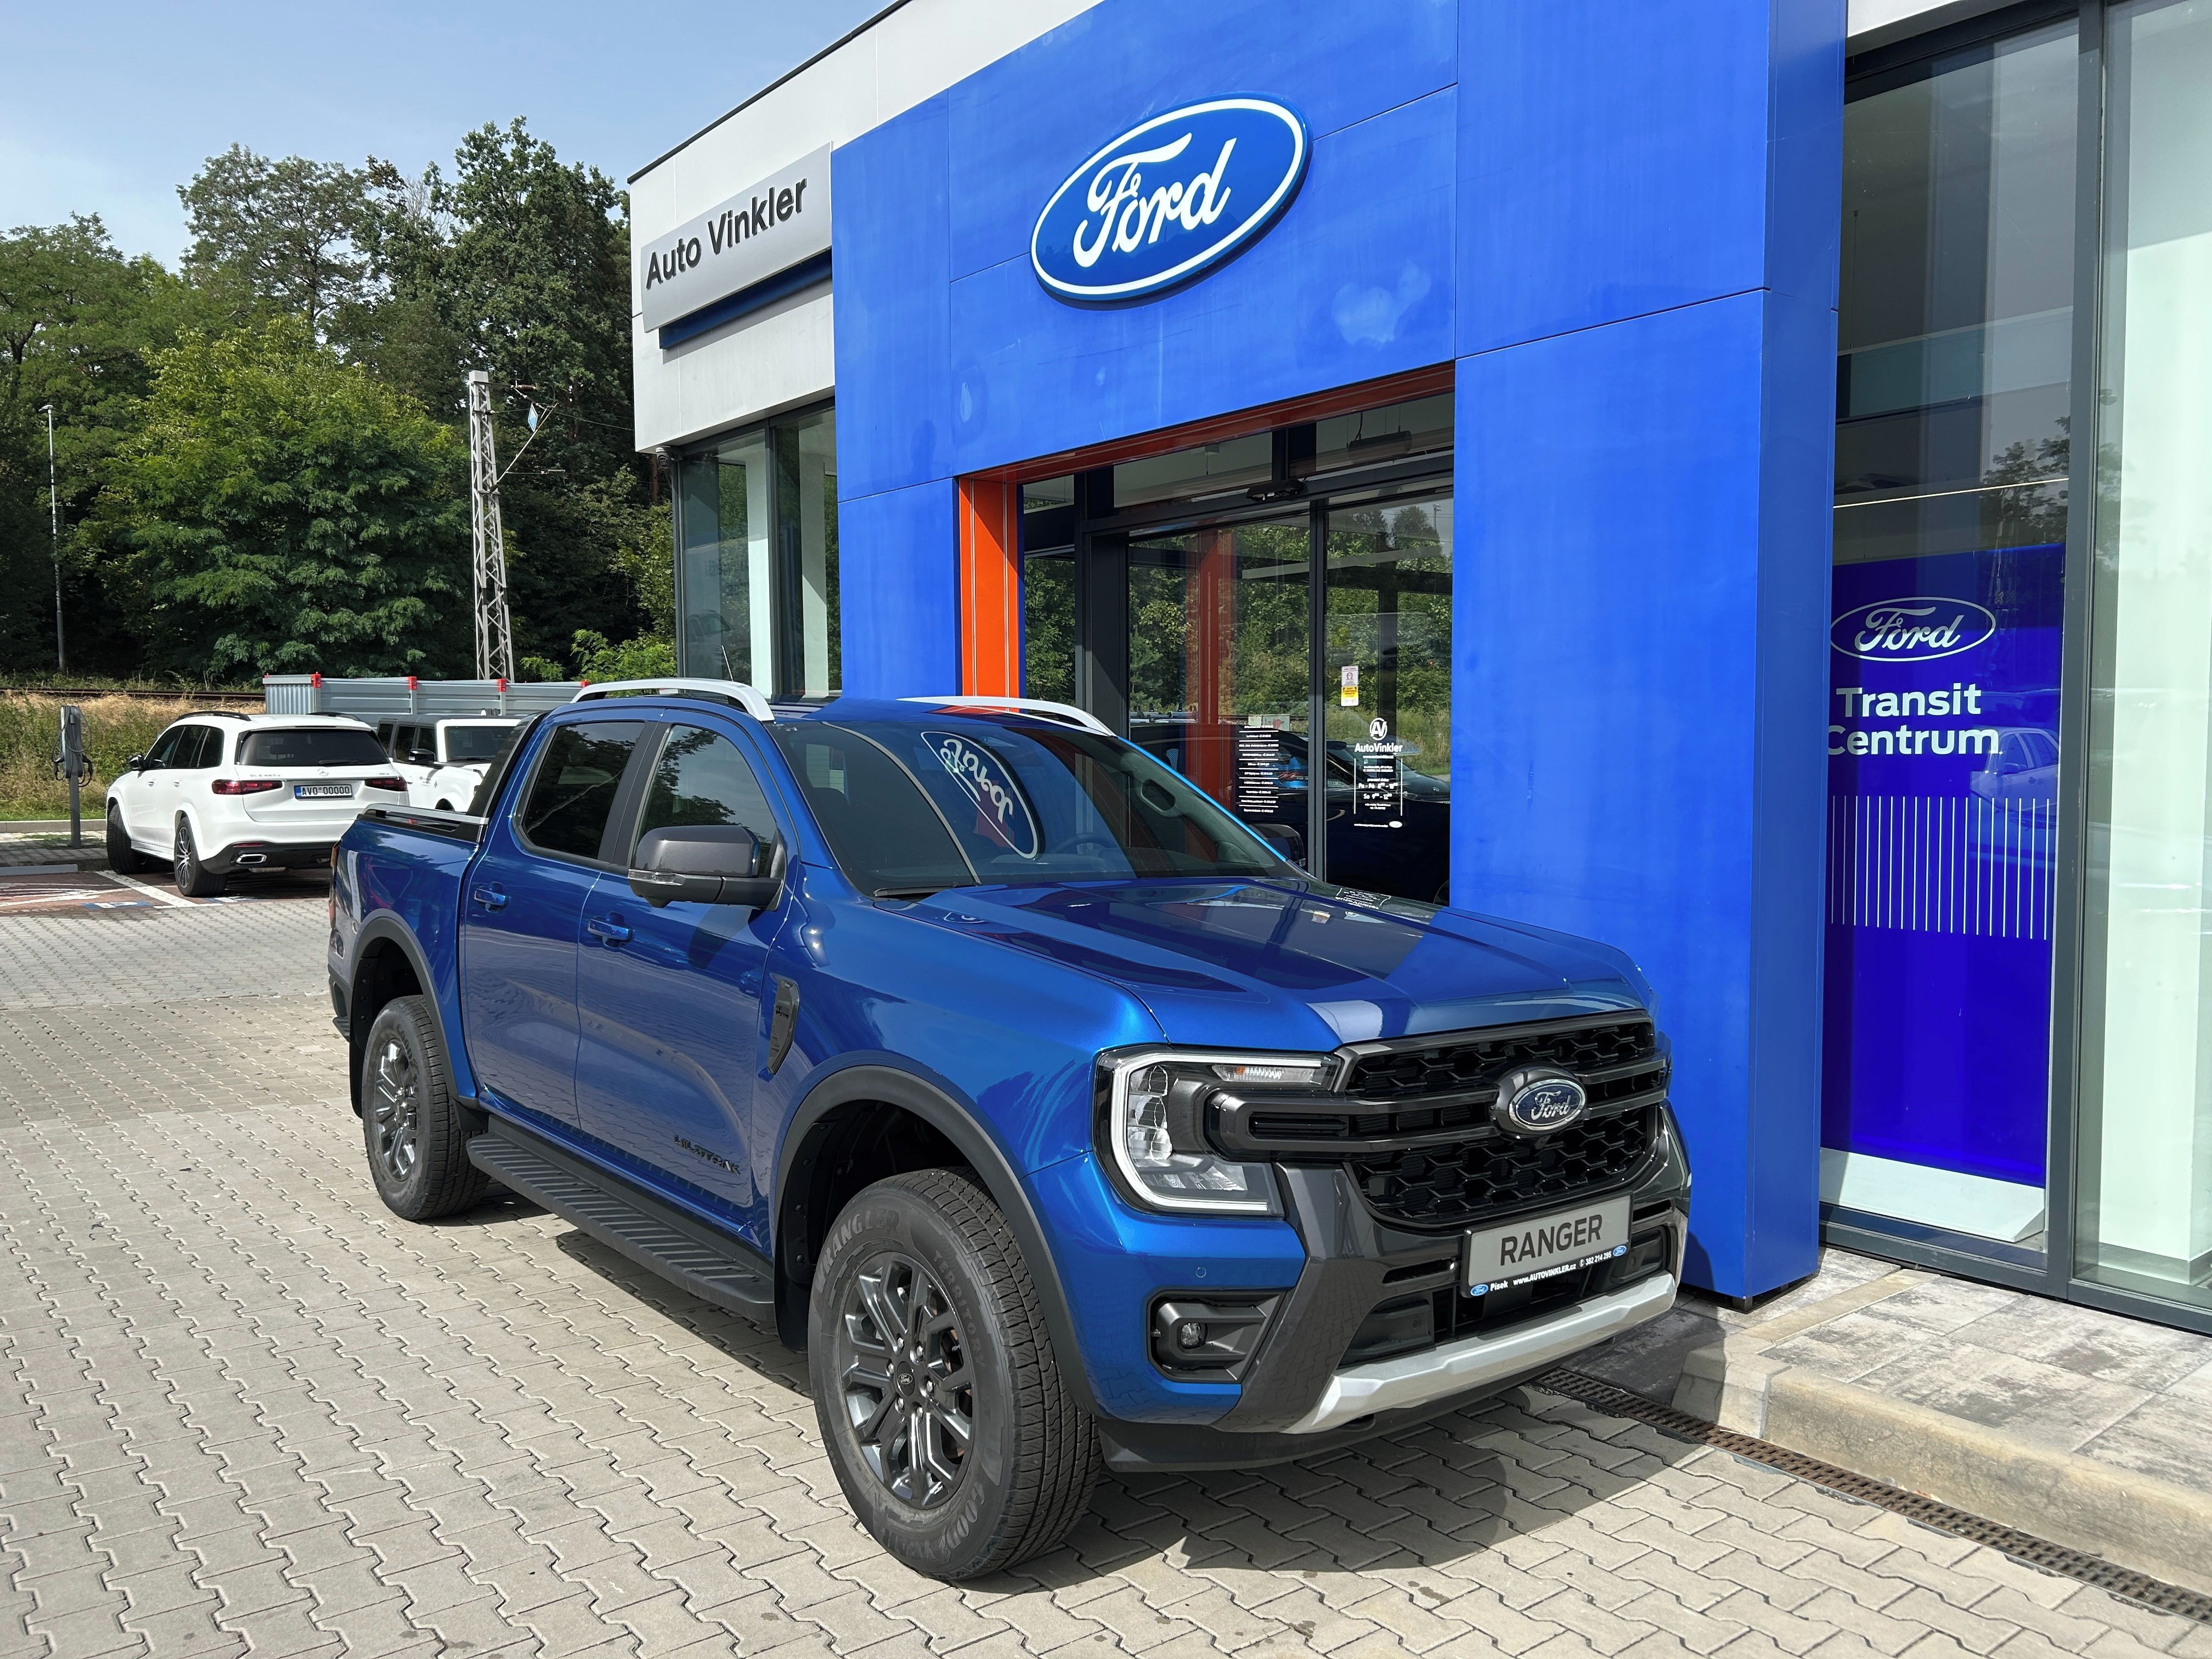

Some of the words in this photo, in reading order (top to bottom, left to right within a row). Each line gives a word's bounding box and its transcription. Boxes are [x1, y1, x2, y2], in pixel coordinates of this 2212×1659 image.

[1073, 132, 1237, 267] Ford
[646, 236, 702, 290] Auto
[707, 178, 807, 255] Vinkler
[1854, 607, 1964, 651] Ford
[1836, 682, 1982, 717] Transit
[1355, 742, 1403, 752] AutoVinkler
[1828, 724, 2000, 755] Centrum
[1531, 1090, 1571, 1120] Ford
[815, 1208, 900, 1294] WRANGLER
[1500, 1214, 1602, 1266] RANGER
[1513, 1263, 1577, 1285] www.AUTOVINKLER.cz
